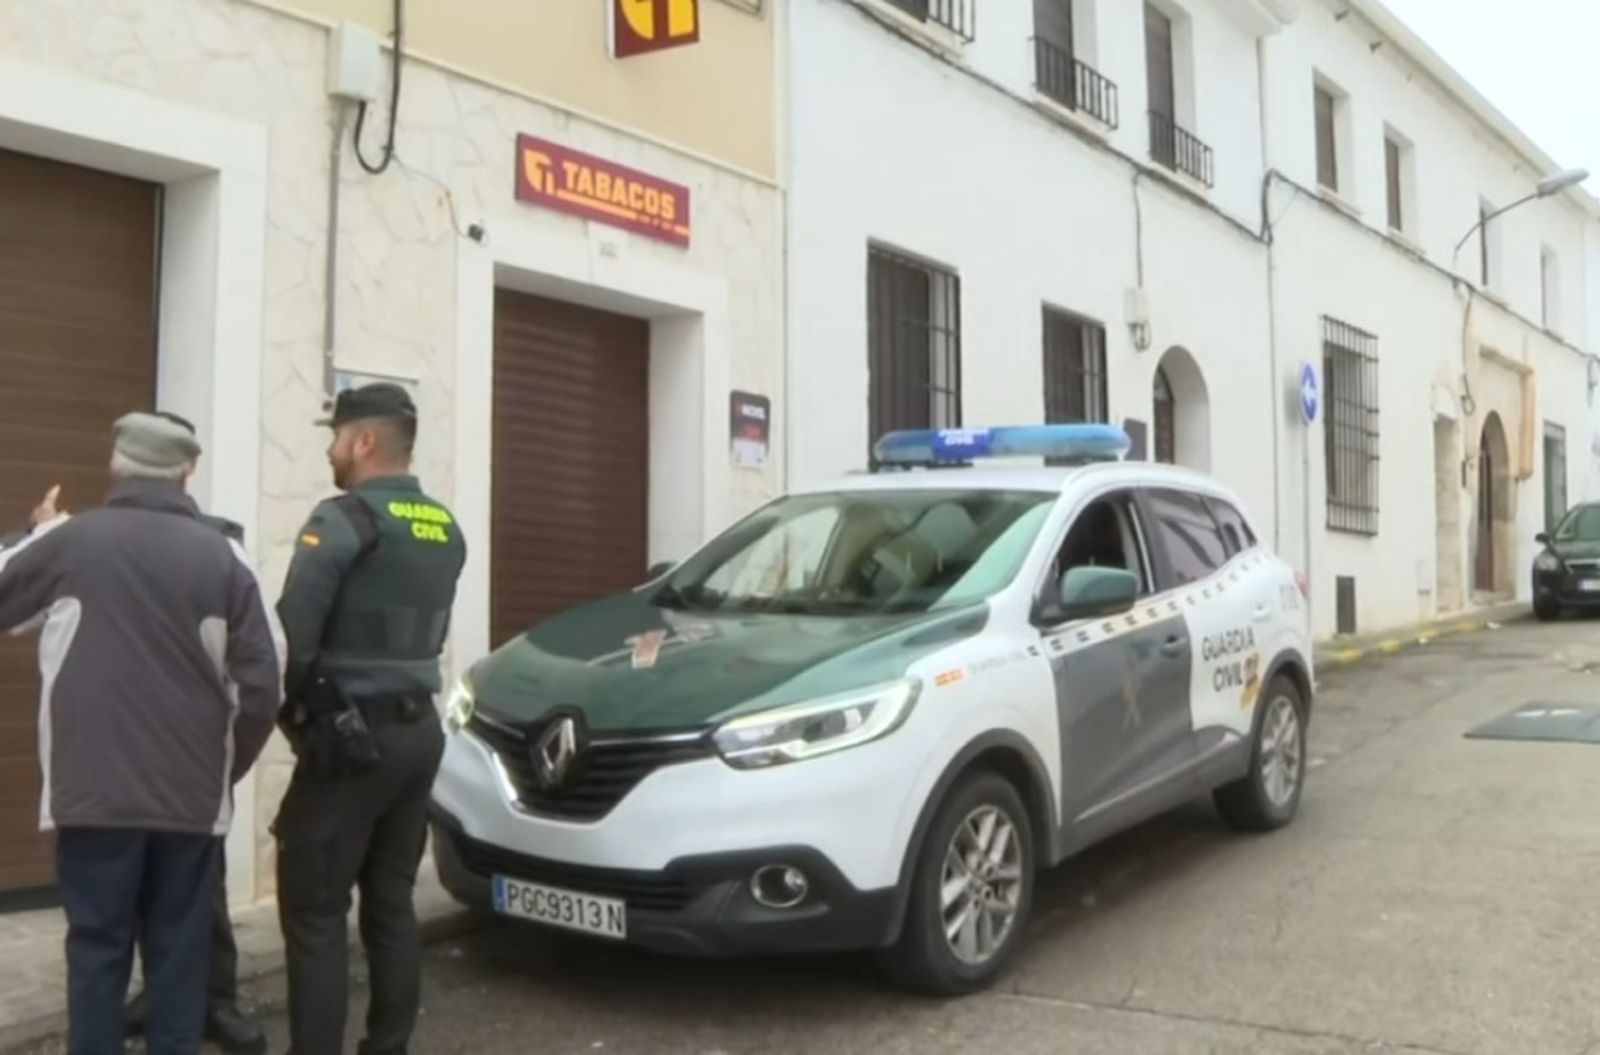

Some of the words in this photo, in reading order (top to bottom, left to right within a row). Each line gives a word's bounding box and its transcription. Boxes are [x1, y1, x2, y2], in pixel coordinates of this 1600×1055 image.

[562, 160, 676, 221] TABACOS
[411, 520, 449, 543] CIVIL
[1202, 626, 1255, 661] GUARDIA
[1213, 661, 1244, 692] CIVIL
